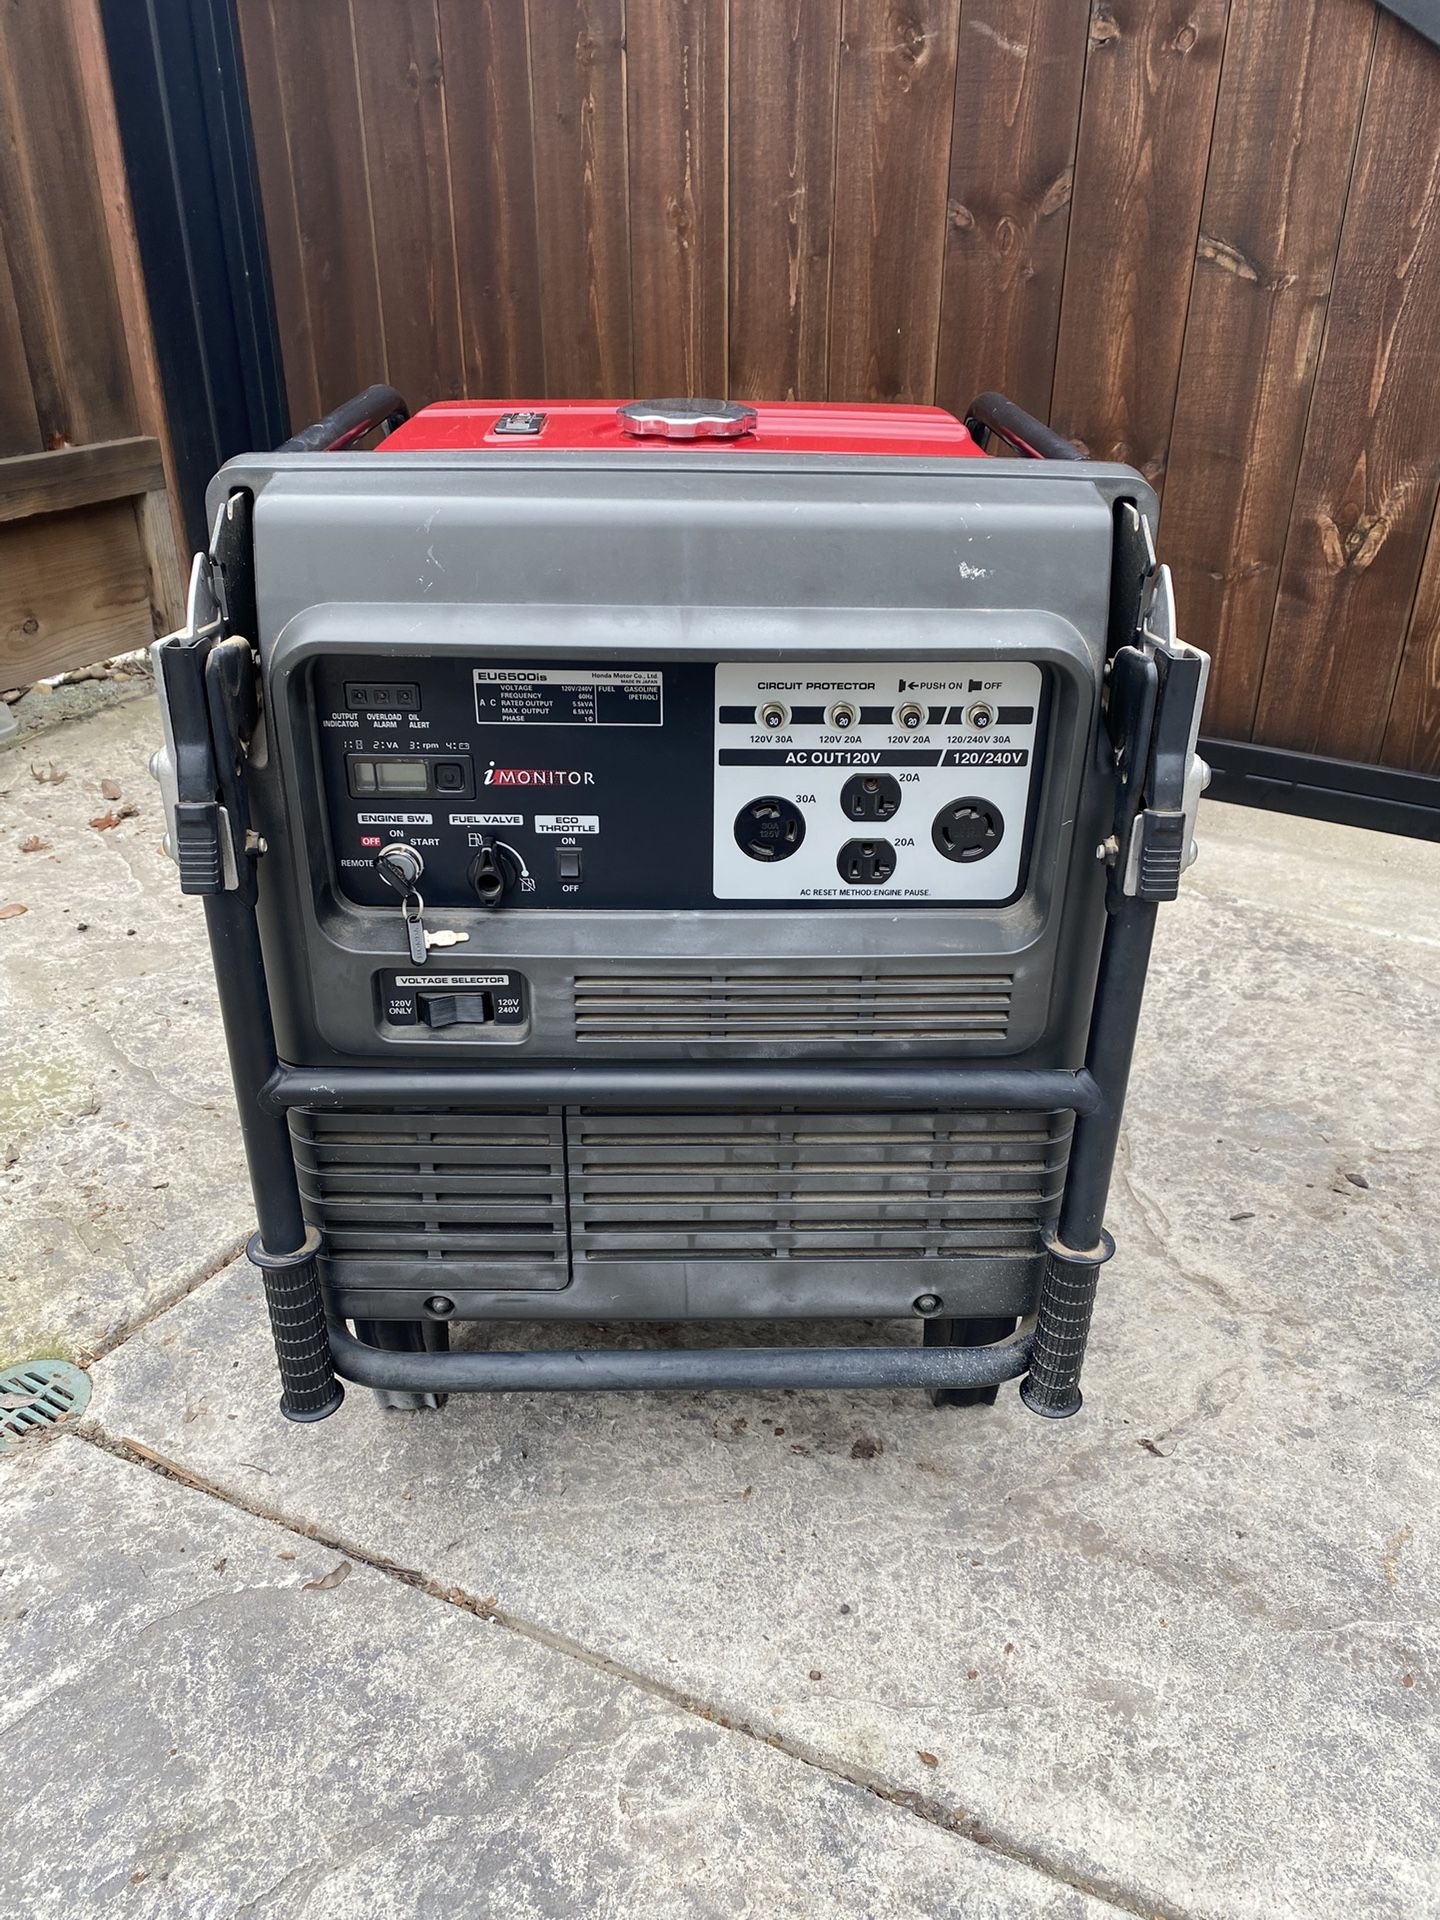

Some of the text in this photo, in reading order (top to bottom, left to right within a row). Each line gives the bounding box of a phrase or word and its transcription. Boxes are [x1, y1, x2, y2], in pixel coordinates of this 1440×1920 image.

[478, 672, 547, 681] EU6500is
[758, 682, 876, 690] CIRCUIT PROTECTOR
[888, 736, 931, 744] 120V 20A
[947, 736, 1011, 744] 120/240V 30A
[785, 752, 808, 764] AC
[953, 752, 1022, 764] 120/240V
[499, 771, 595, 785] MONITOR
[899, 774, 920, 782] 20A
[796, 795, 816, 803] 30A
[561, 837, 576, 845] ON
[895, 838, 915, 846] 20A
[341, 859, 374, 867] REMOTE
